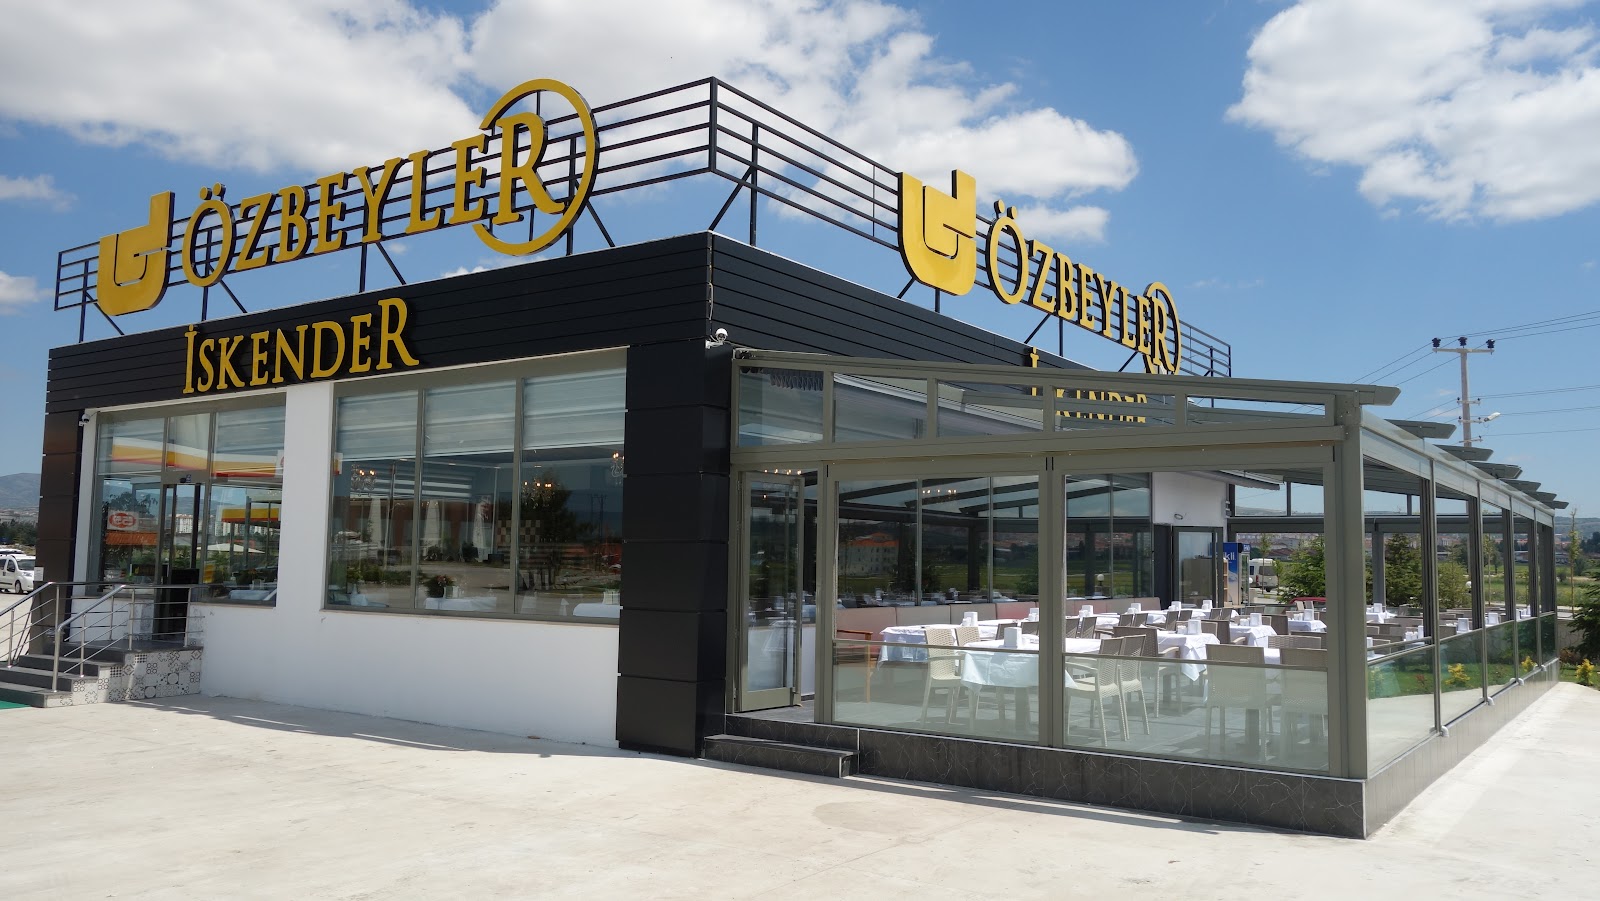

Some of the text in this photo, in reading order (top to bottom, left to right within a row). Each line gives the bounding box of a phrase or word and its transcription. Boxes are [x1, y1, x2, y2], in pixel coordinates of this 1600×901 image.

[182, 111, 566, 287] ÖZBEYLER
[183, 298, 419, 395] İSKENDER
[985, 200, 1175, 372] ÖZBEYLER
